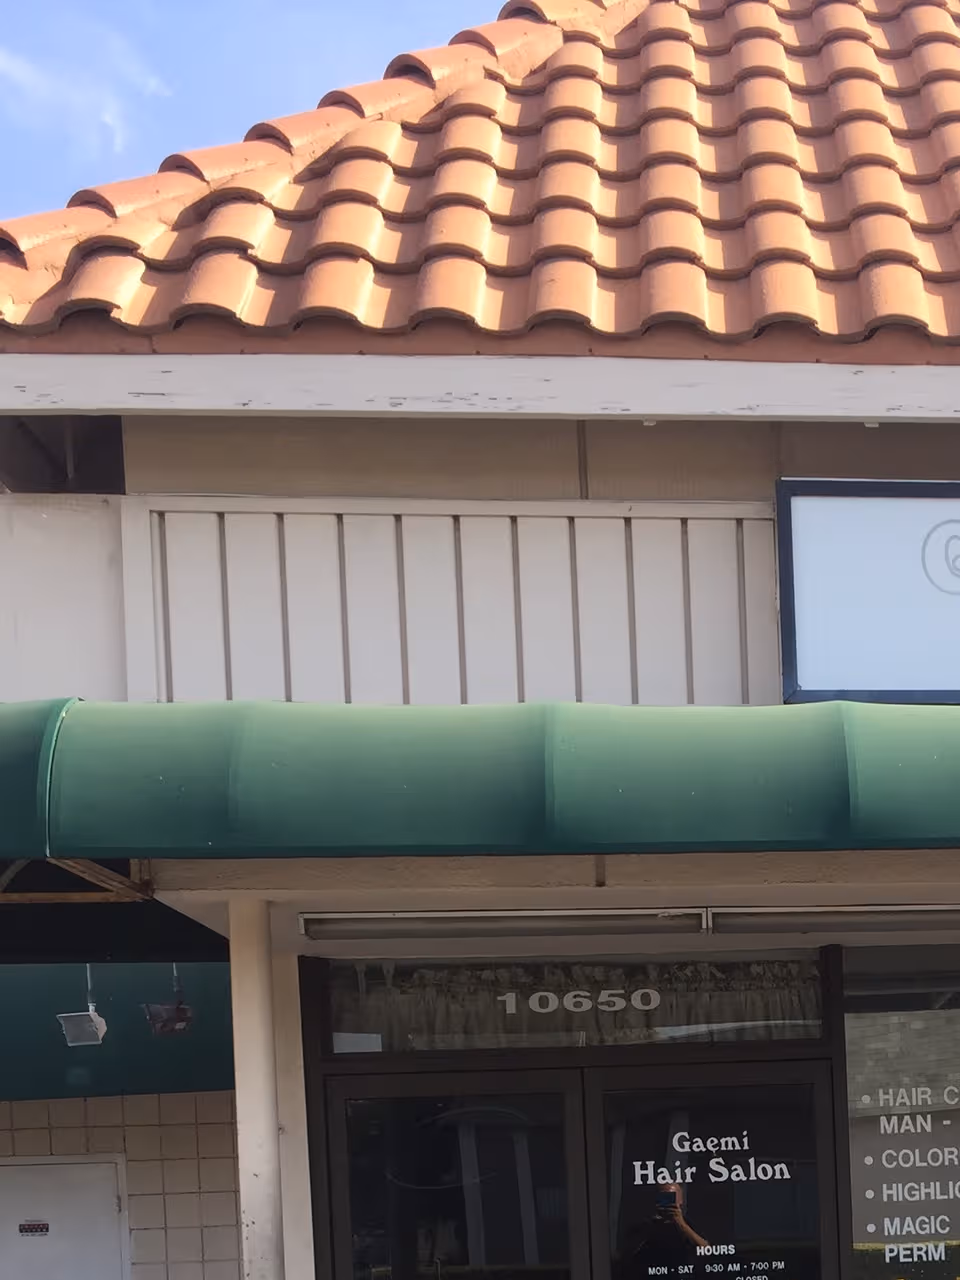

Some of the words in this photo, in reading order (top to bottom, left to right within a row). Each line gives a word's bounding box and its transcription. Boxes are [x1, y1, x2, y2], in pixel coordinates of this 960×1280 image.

[497, 988, 661, 1014] 10650
[878, 1087, 932, 1107] HAIR
[880, 1114, 932, 1134] MAN
[672, 1130, 750, 1153] Gaemi
[633, 1160, 697, 1185] Hair
[708, 1157, 791, 1183] Salon
[884, 1215, 950, 1236] MAGIC
[696, 1244, 735, 1256] HOURS
[885, 1242, 945, 1263] PERM
[648, 1266, 668, 1275] MON
[678, 1264, 694, 1274] SAT
[705, 1263, 724, 1272] 9:30
[727, 1263, 741, 1271] AM
[751, 1261, 769, 1270] 7:00
[772, 1260, 785, 1269] PM
